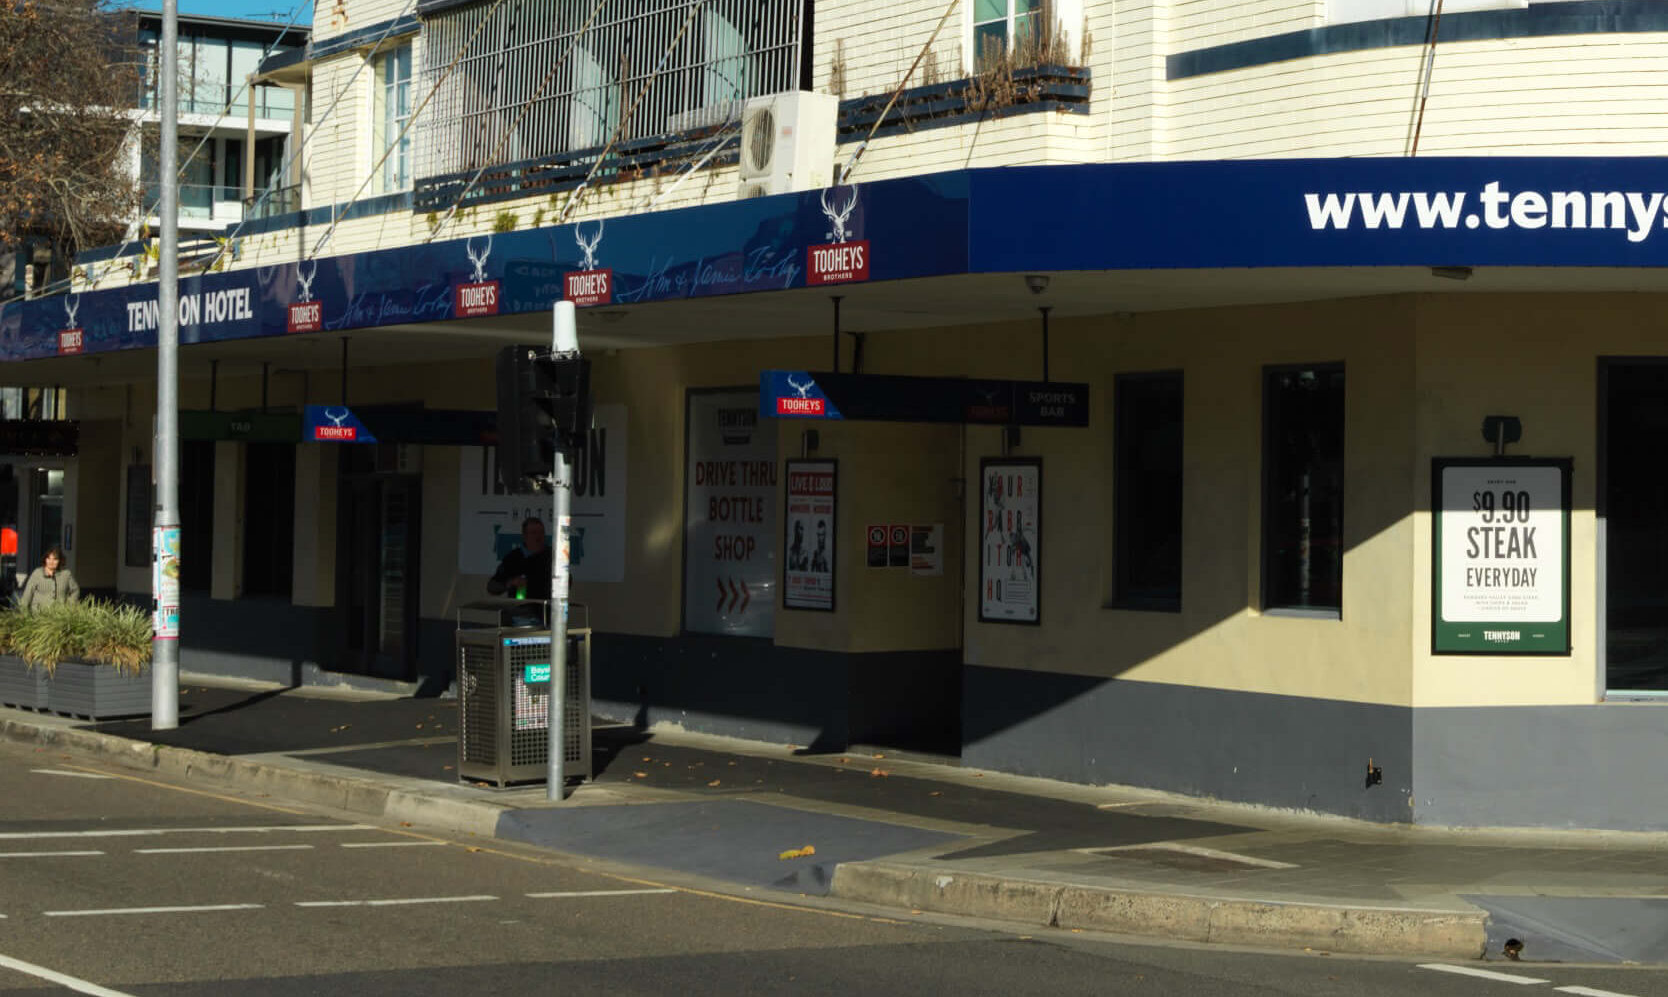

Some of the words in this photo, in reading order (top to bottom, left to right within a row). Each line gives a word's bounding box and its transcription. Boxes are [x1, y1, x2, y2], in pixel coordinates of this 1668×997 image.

[813, 246, 863, 274] TOOHEYS
[568, 273, 607, 297] TOOHEYS
[823, 272, 853, 281] BROTHERS
[461, 285, 495, 308] TOOHEYS
[127, 292, 200, 332] TENNON
[204, 287, 253, 323] HOTEL
[291, 304, 319, 324] TOOHEYS
[782, 399, 821, 411] TOOHEYS
[1029, 391, 1076, 404] SPORTS
[1040, 406, 1065, 418] BAR
[319, 427, 353, 438] TOOHEYS
[695, 461, 736, 486] DRIVE
[742, 461, 777, 486] THRU
[709, 496, 763, 523] BOTTLE
[1473, 490, 1530, 524] $9.90
[715, 535, 755, 561] SHOP
[1466, 526, 1537, 559] STEAK
[1466, 567, 1538, 588] EVERYDAY
[1483, 630, 1520, 640] TENNYSON
